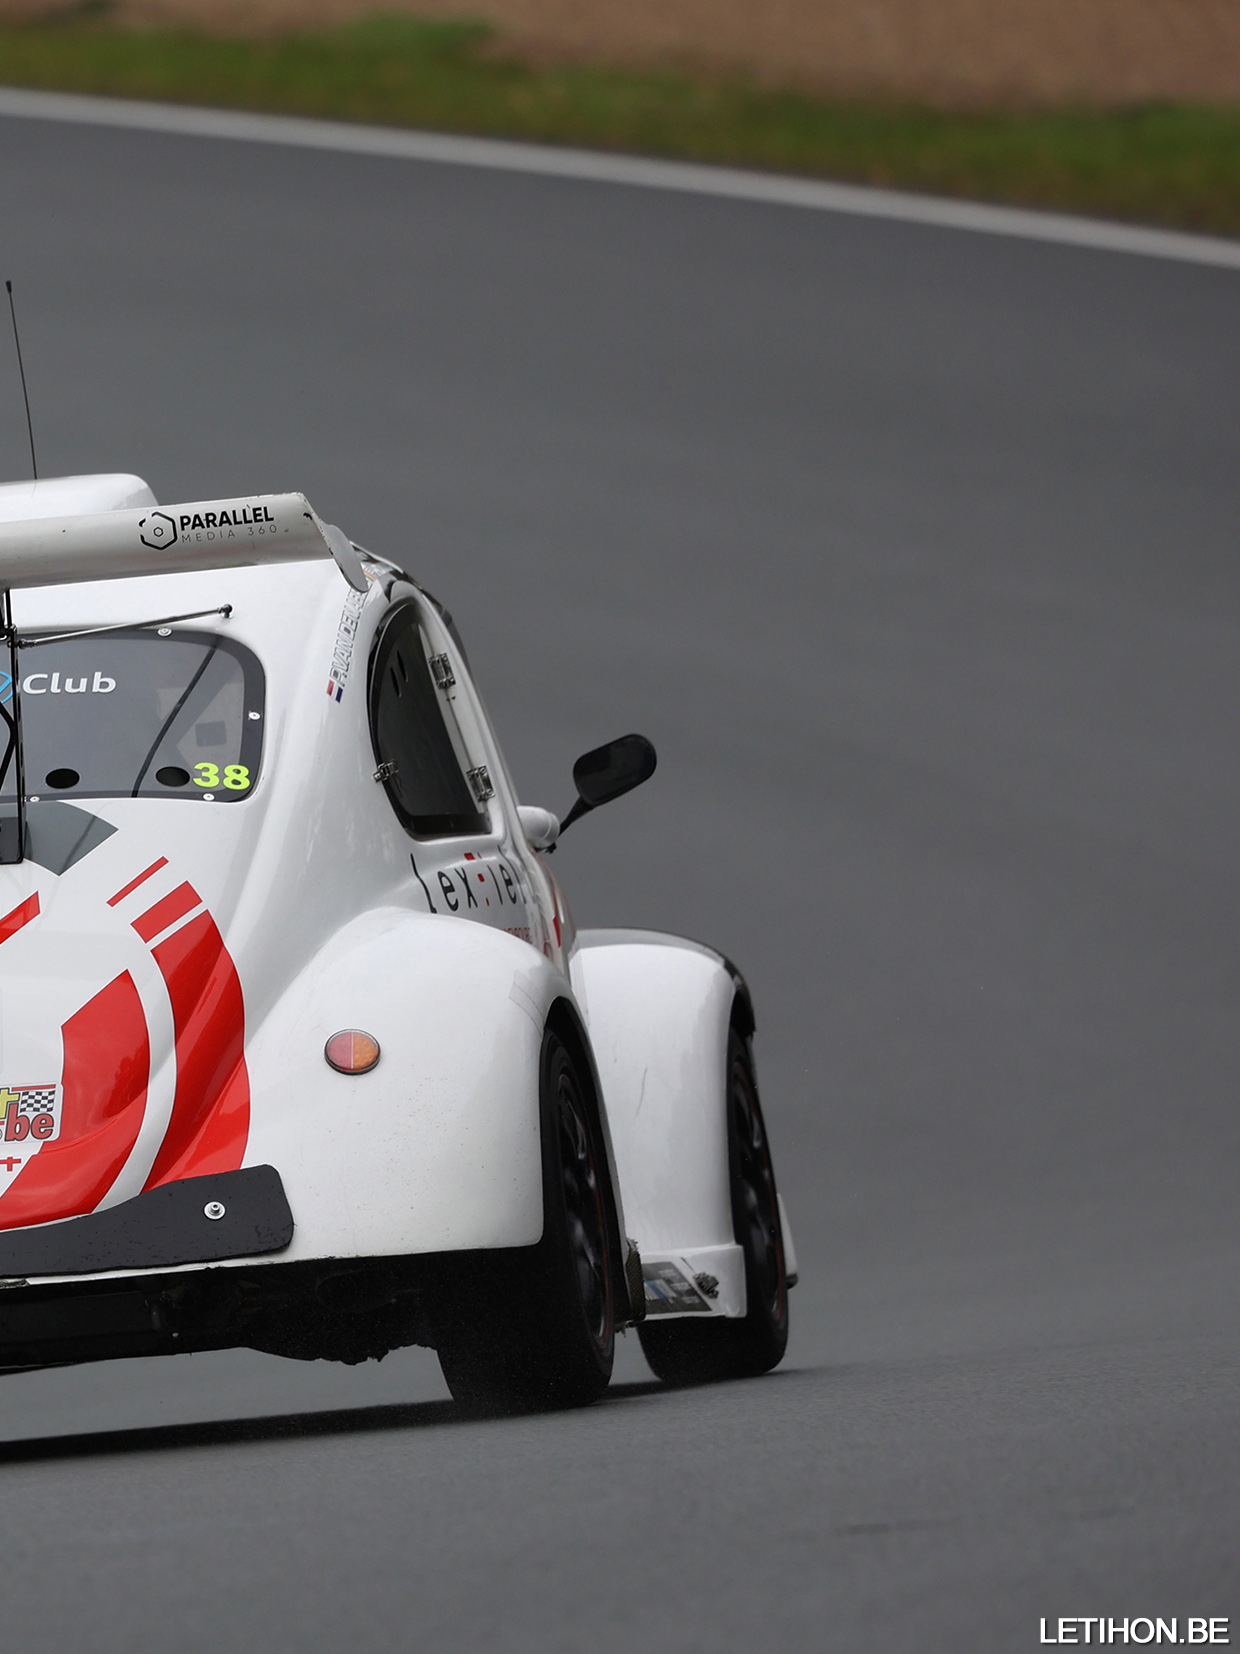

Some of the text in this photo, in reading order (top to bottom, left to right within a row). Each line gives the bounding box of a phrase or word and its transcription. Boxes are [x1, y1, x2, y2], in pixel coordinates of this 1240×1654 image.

[179, 506, 275, 532] PARALLEL
[181, 524, 278, 543] MEDIA 360
[22, 671, 117, 695] Club
[193, 762, 251, 790] 38
